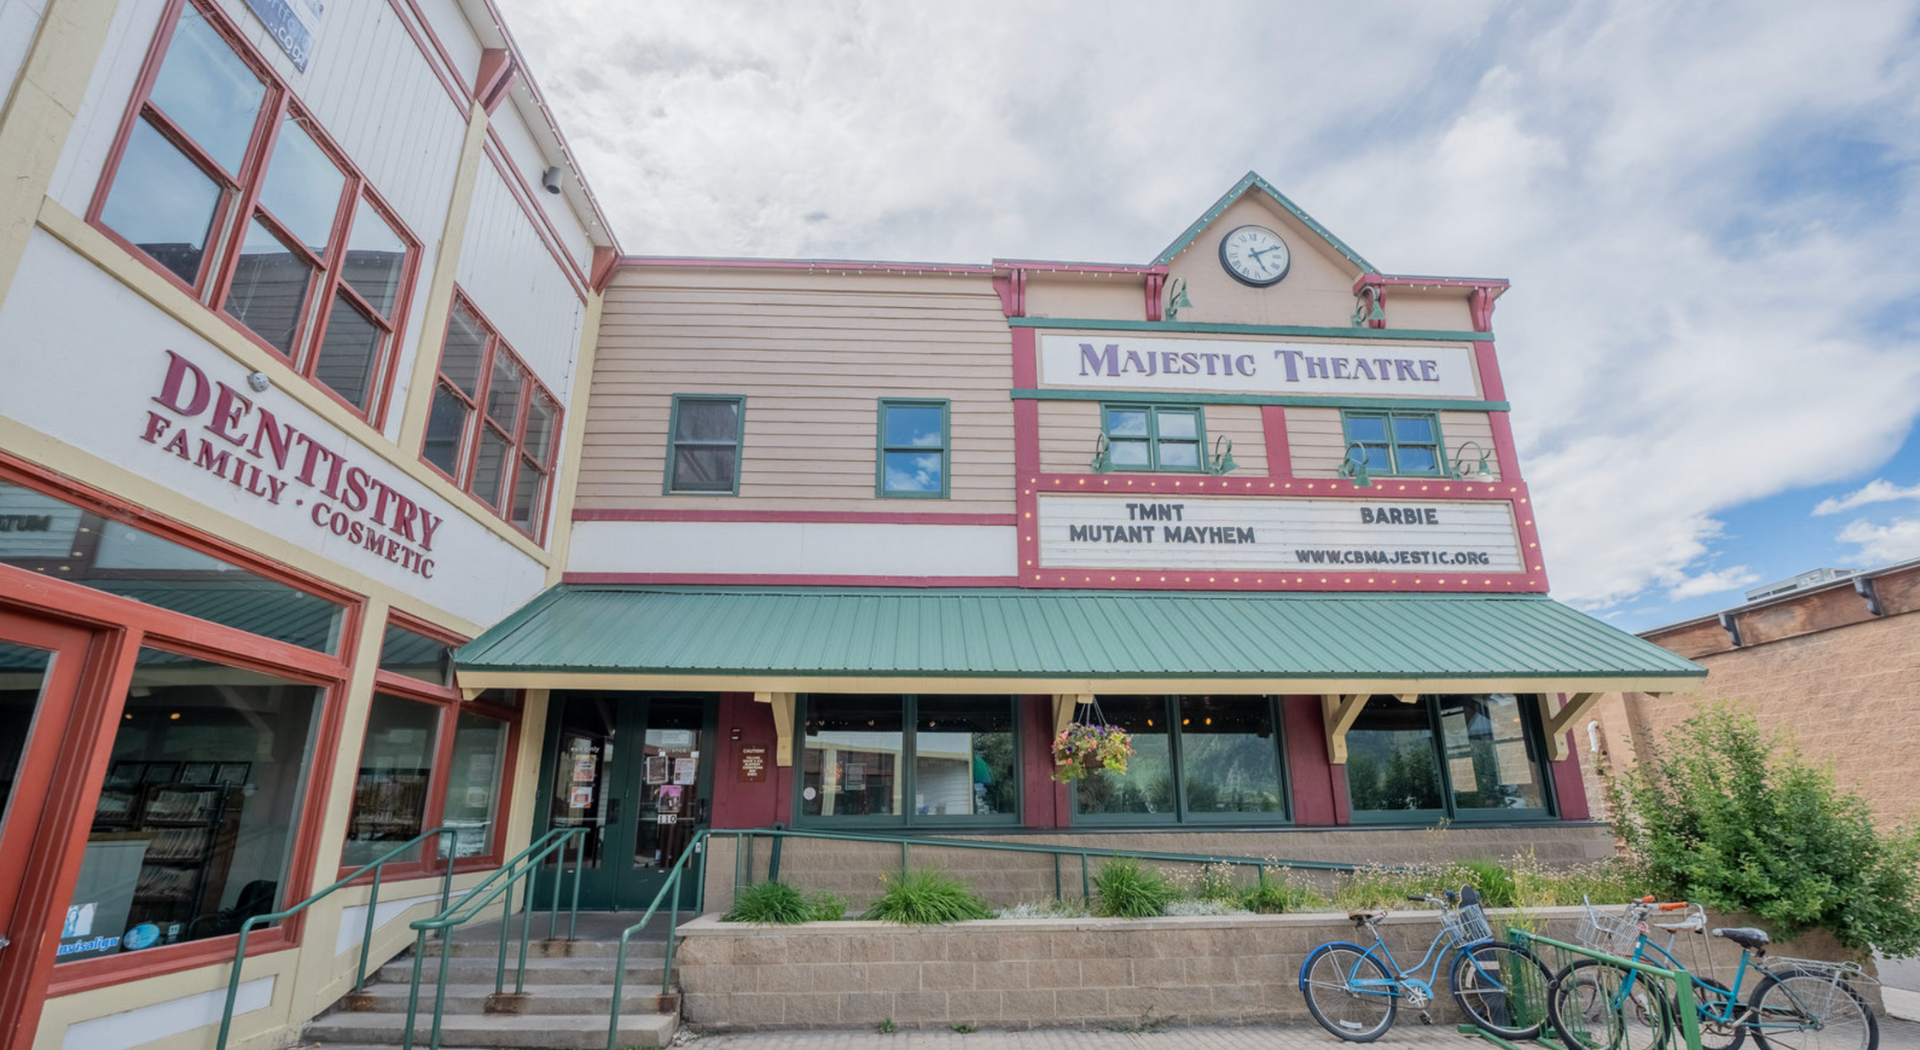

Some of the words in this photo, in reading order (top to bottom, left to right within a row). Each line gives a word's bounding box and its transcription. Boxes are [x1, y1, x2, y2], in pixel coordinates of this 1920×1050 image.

[1078, 343, 1257, 377] MAJESTIC
[1274, 349, 1440, 382] THEATRE
[151, 349, 444, 552] DENTISTRY
[140, 410, 289, 506] FAMILY
[310, 502, 436, 580] COSMETIC
[1126, 503, 1185, 521] TMNT
[1360, 507, 1439, 525] BARBIE
[1069, 524, 1155, 543] MUTANT
[1164, 526, 1256, 544] MAYHEM
[1295, 550, 1490, 565] WWW.CBMAJESTIC.ORG
[659, 815, 677, 824] 110
